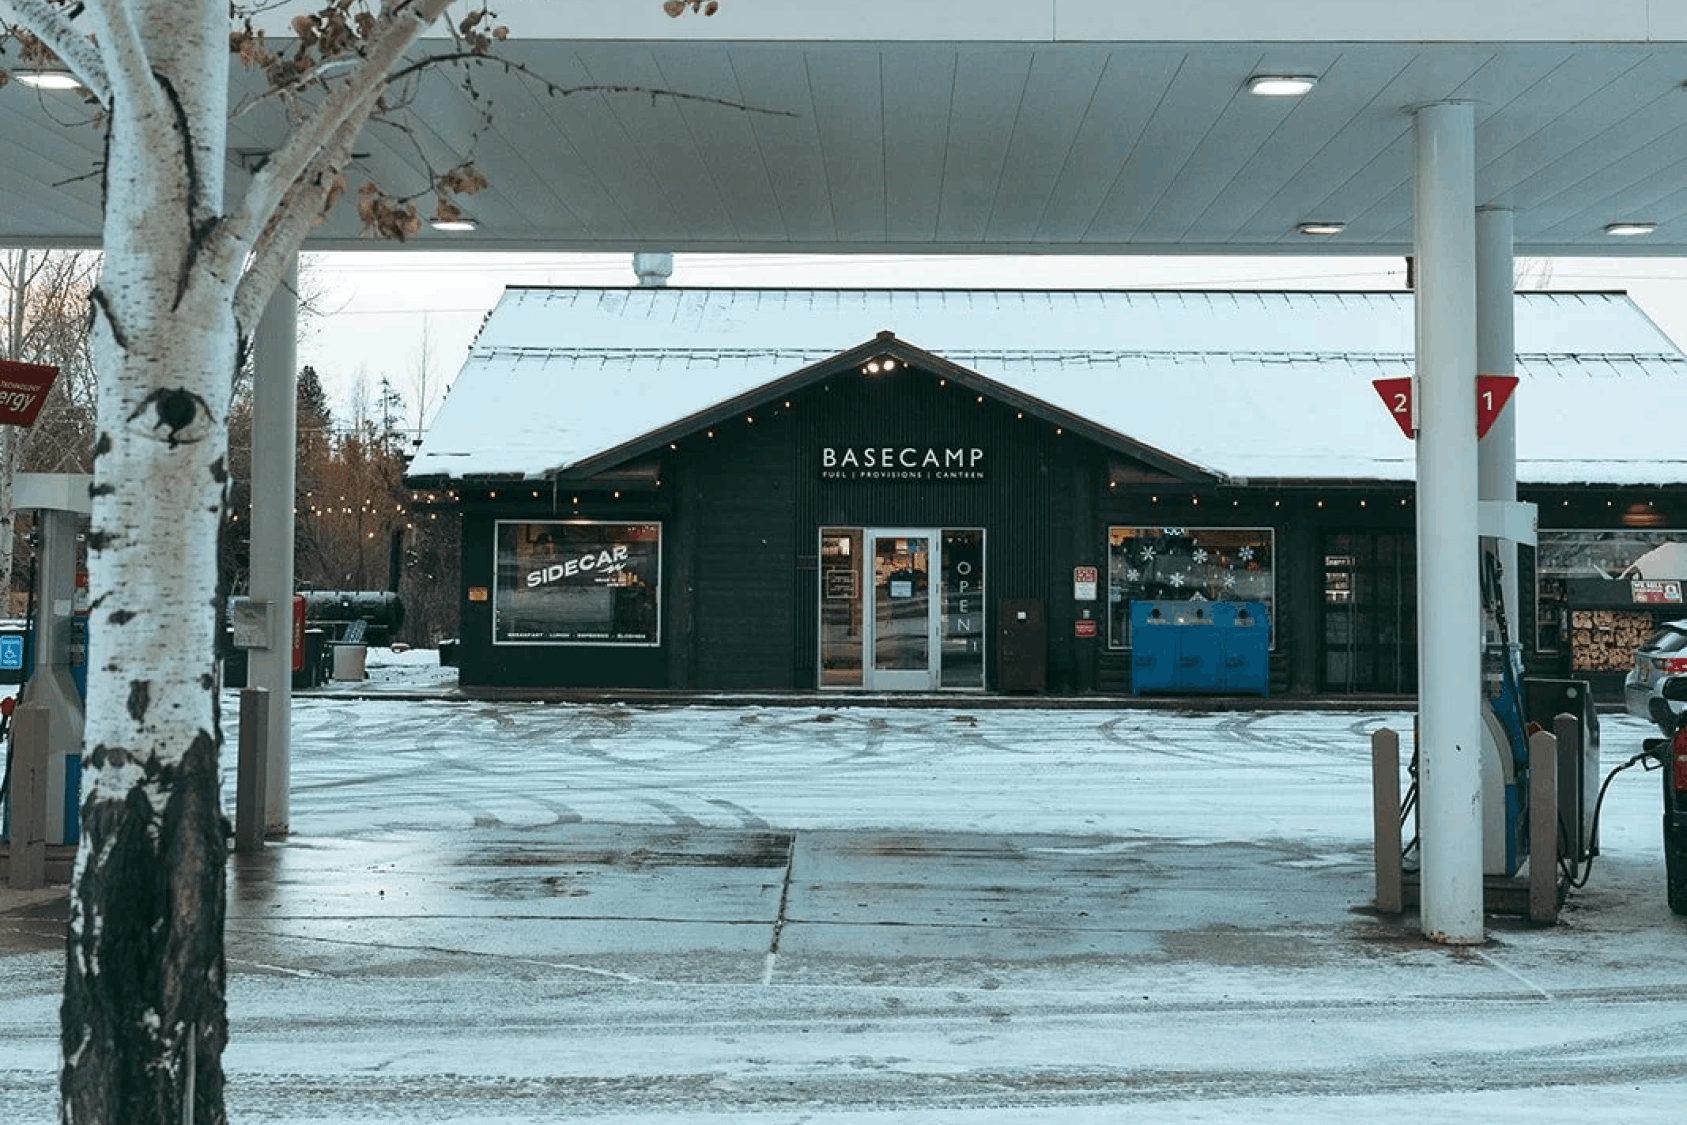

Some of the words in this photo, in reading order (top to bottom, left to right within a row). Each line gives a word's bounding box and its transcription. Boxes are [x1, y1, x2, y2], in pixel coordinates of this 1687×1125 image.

[0, 391, 36, 412] ergy
[1393, 393, 1407, 413] 2
[1482, 391, 1493, 411] 1
[823, 447, 984, 468] BASECAMP
[822, 471, 847, 479] FUEL
[860, 471, 923, 479] PROVISIONS
[936, 471, 984, 479] CANTEEN
[526, 545, 629, 588] SIDECAR
[956, 561, 972, 631] OPEN
